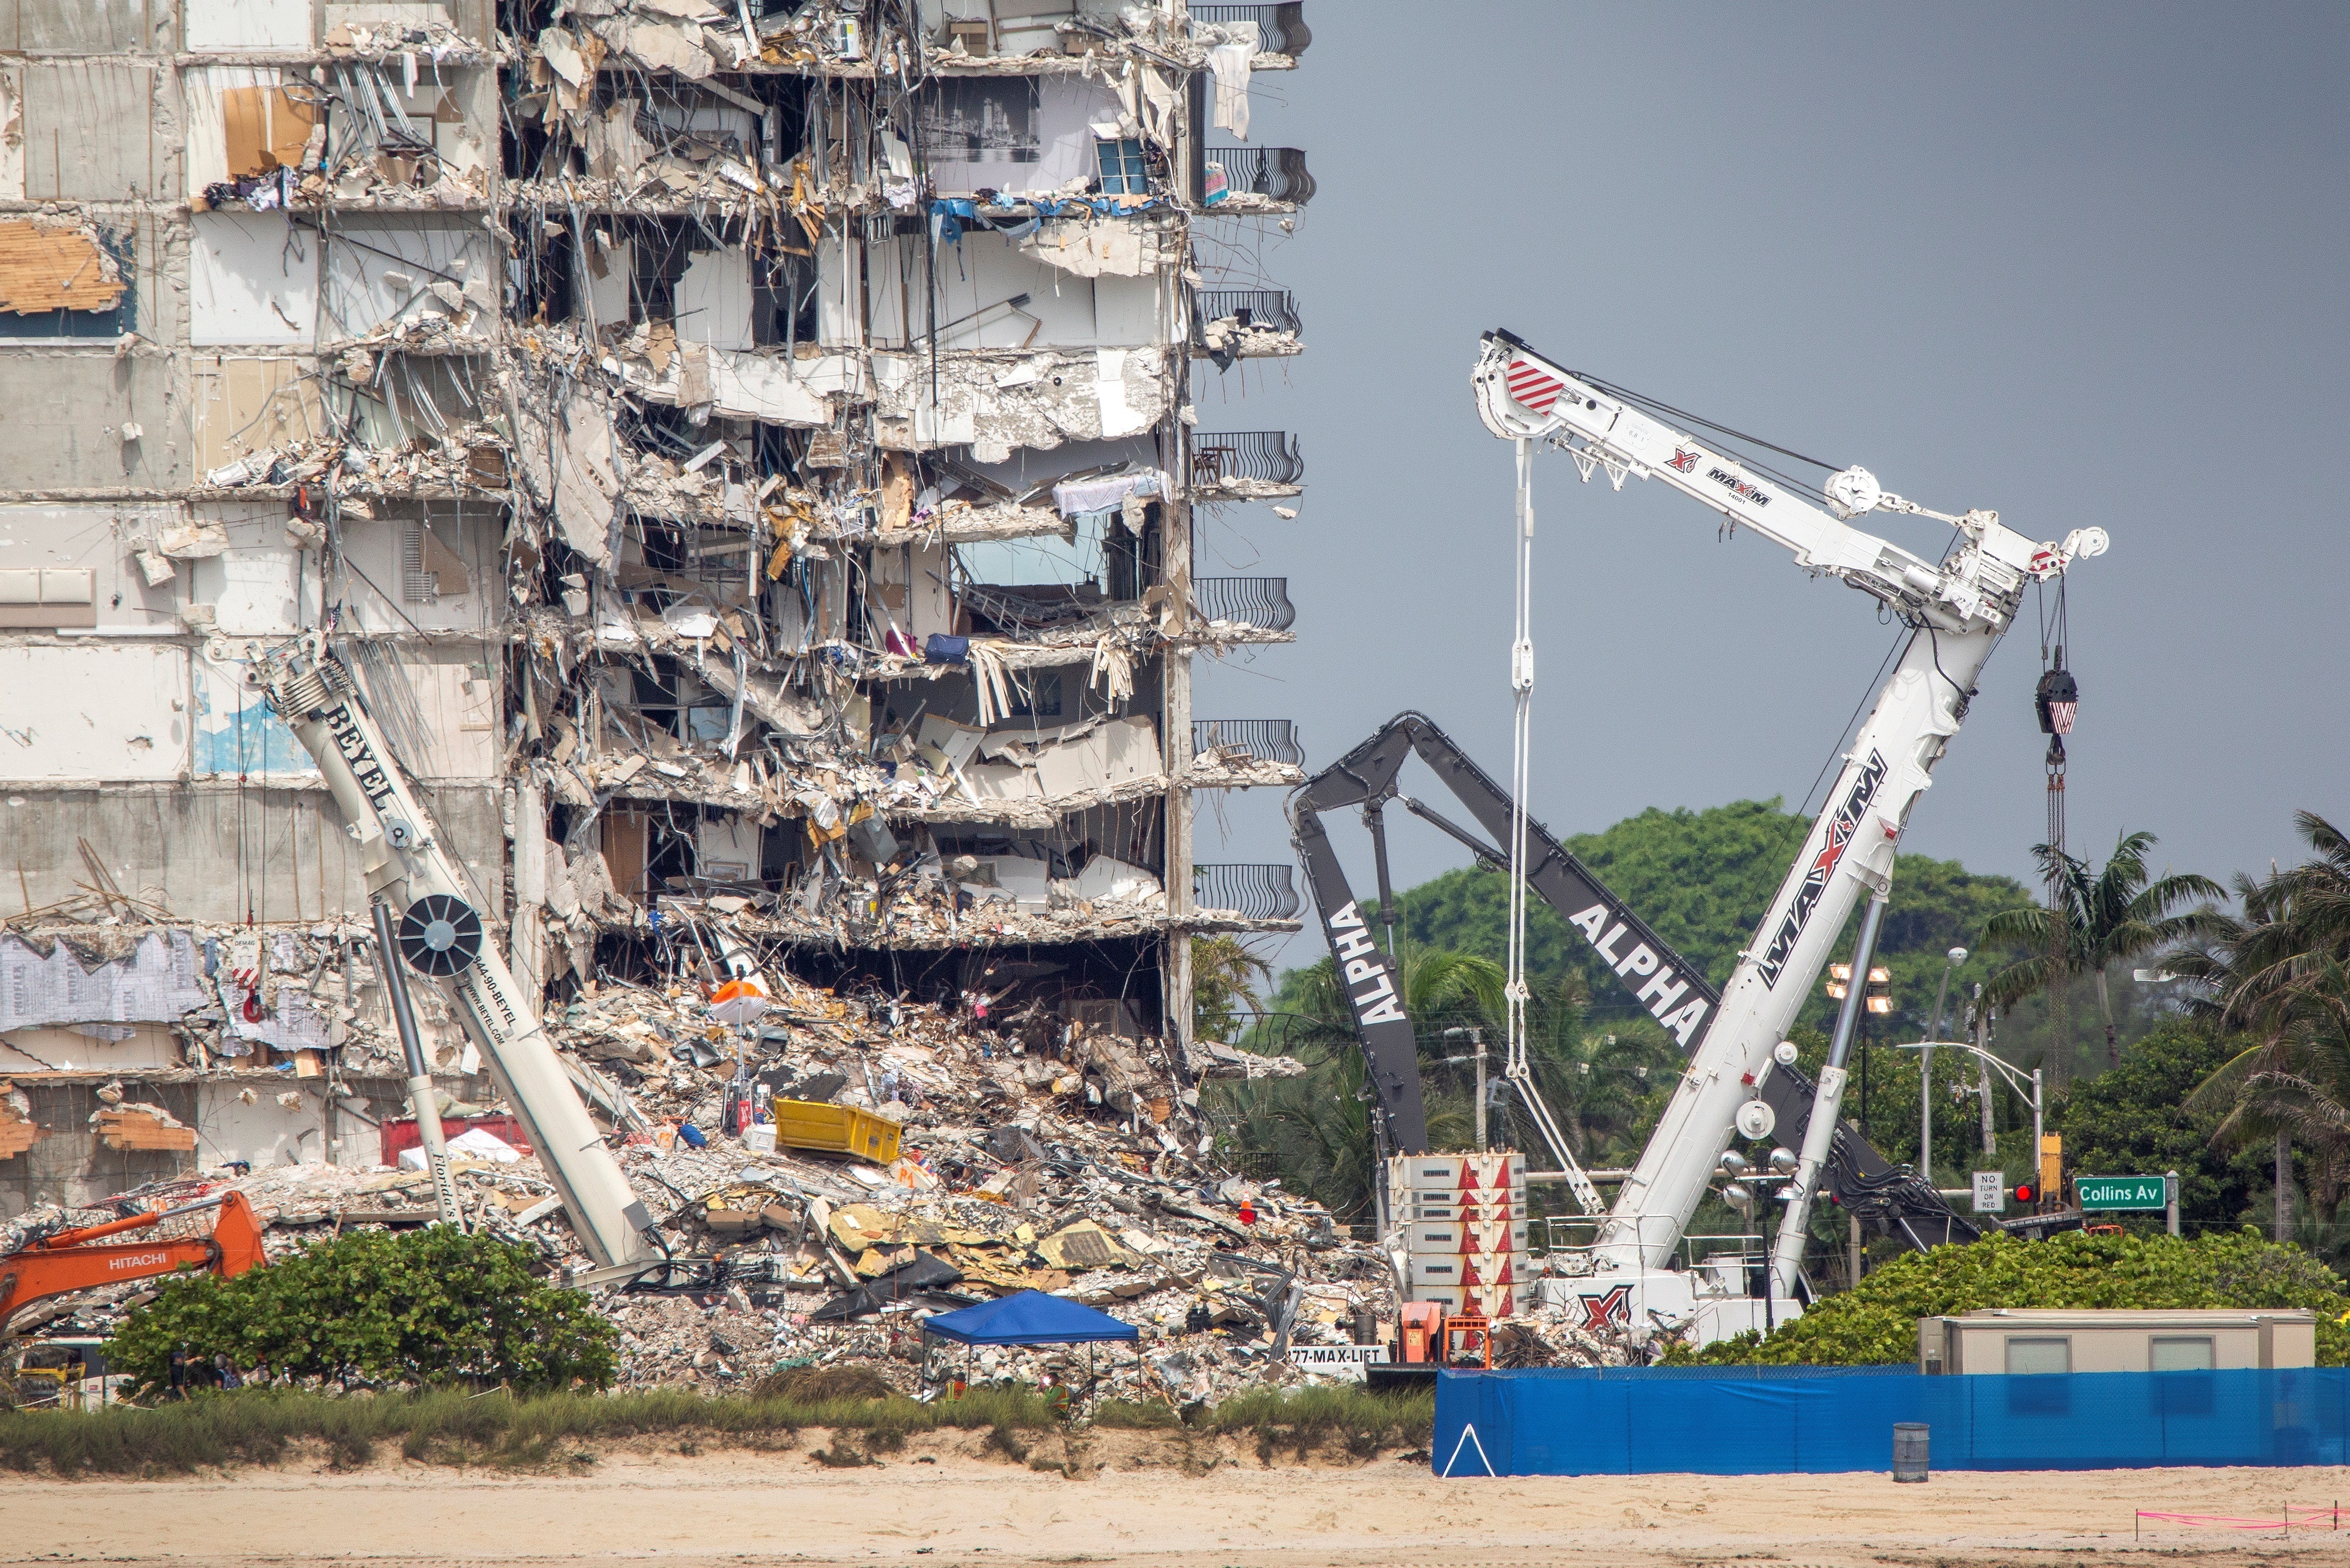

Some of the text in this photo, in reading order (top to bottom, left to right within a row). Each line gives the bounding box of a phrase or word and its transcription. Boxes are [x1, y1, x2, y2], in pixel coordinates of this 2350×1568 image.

[1707, 467, 1772, 508] MAXIM
[1728, 492, 1746, 505] 14001
[323, 701, 395, 812] BEYEL
[1757, 747, 1888, 991] MAXIM
[1329, 900, 1406, 1025] ALPHA
[1569, 904, 1708, 1047] ALPHA
[467, 985, 505, 1045] WWW.BEYEL.COM
[432, 1154, 456, 1217] Florida's
[898, 1167, 914, 1188] P1
[2080, 1185, 2157, 1201] Collins Av
[109, 1253, 166, 1270] HITACHI
[1287, 1349, 1379, 1363] 77-MAX-LIFT
